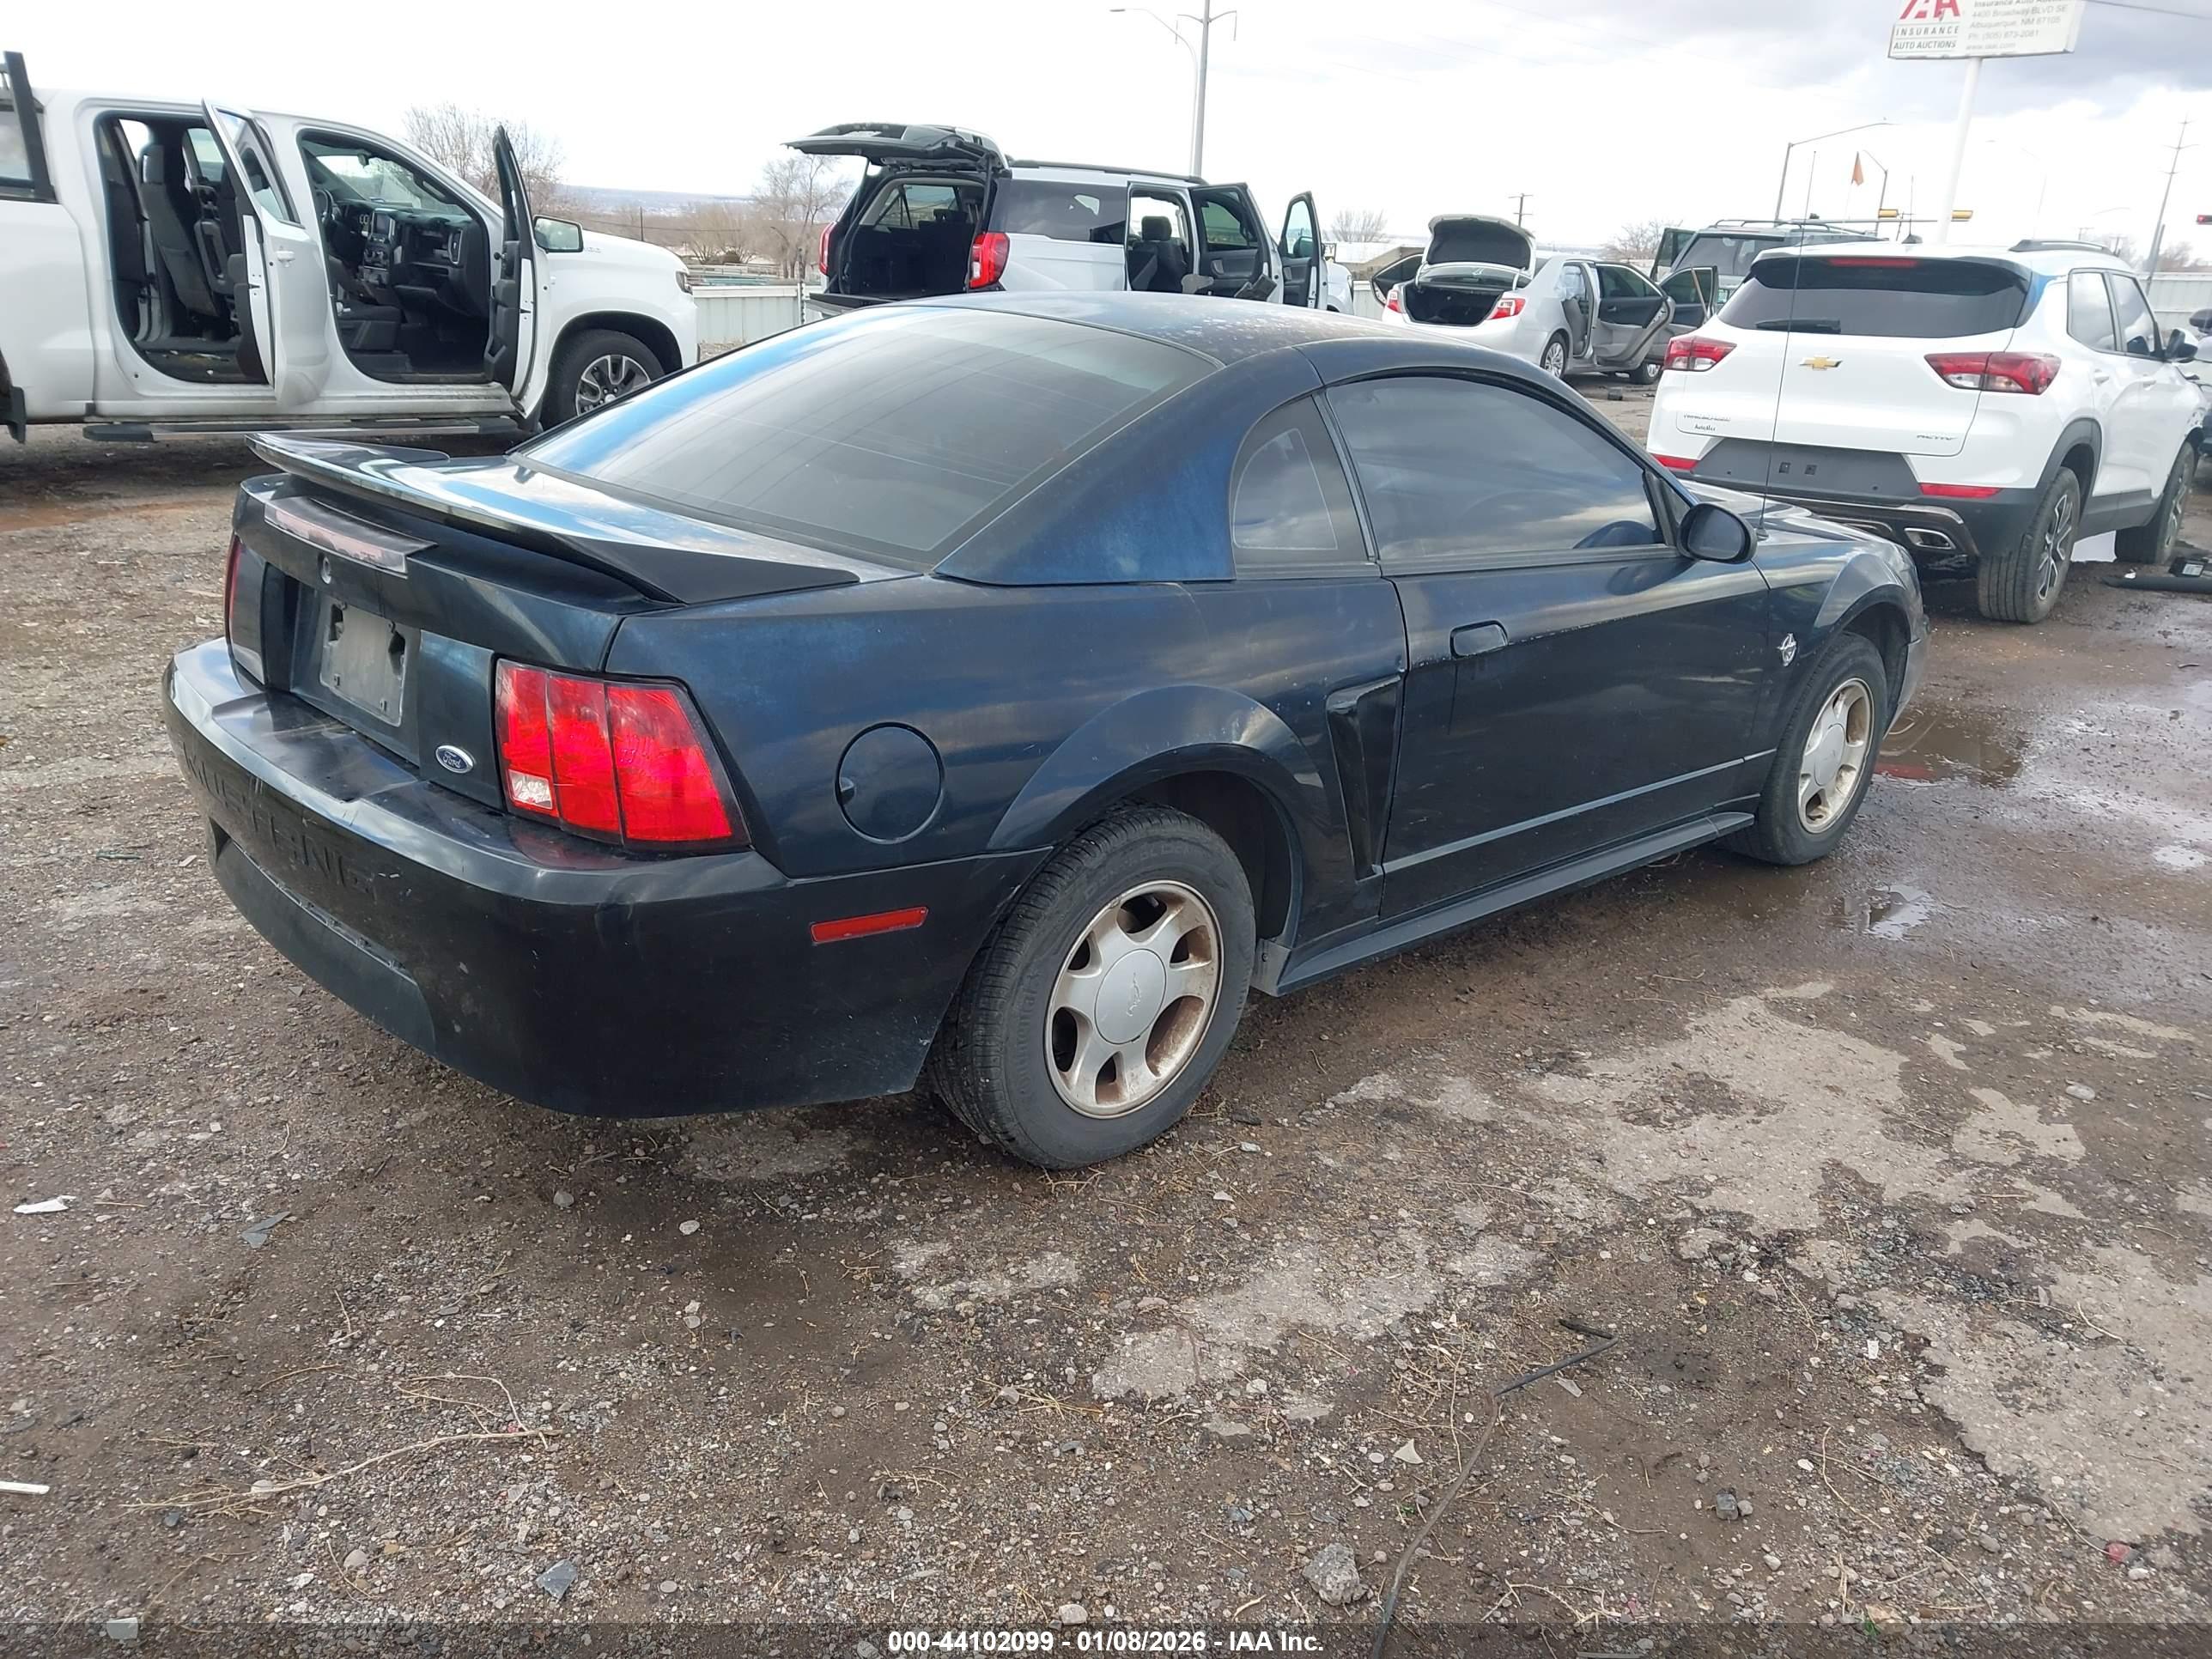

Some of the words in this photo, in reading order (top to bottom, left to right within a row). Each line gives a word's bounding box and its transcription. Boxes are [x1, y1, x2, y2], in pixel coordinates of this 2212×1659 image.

[2056, 4, 2069, 13] SE
[1895, 26, 1960, 36] INSURANCE
[1893, 41, 1915, 50] AUTO
[1916, 40, 1957, 49] AUCTIONS
